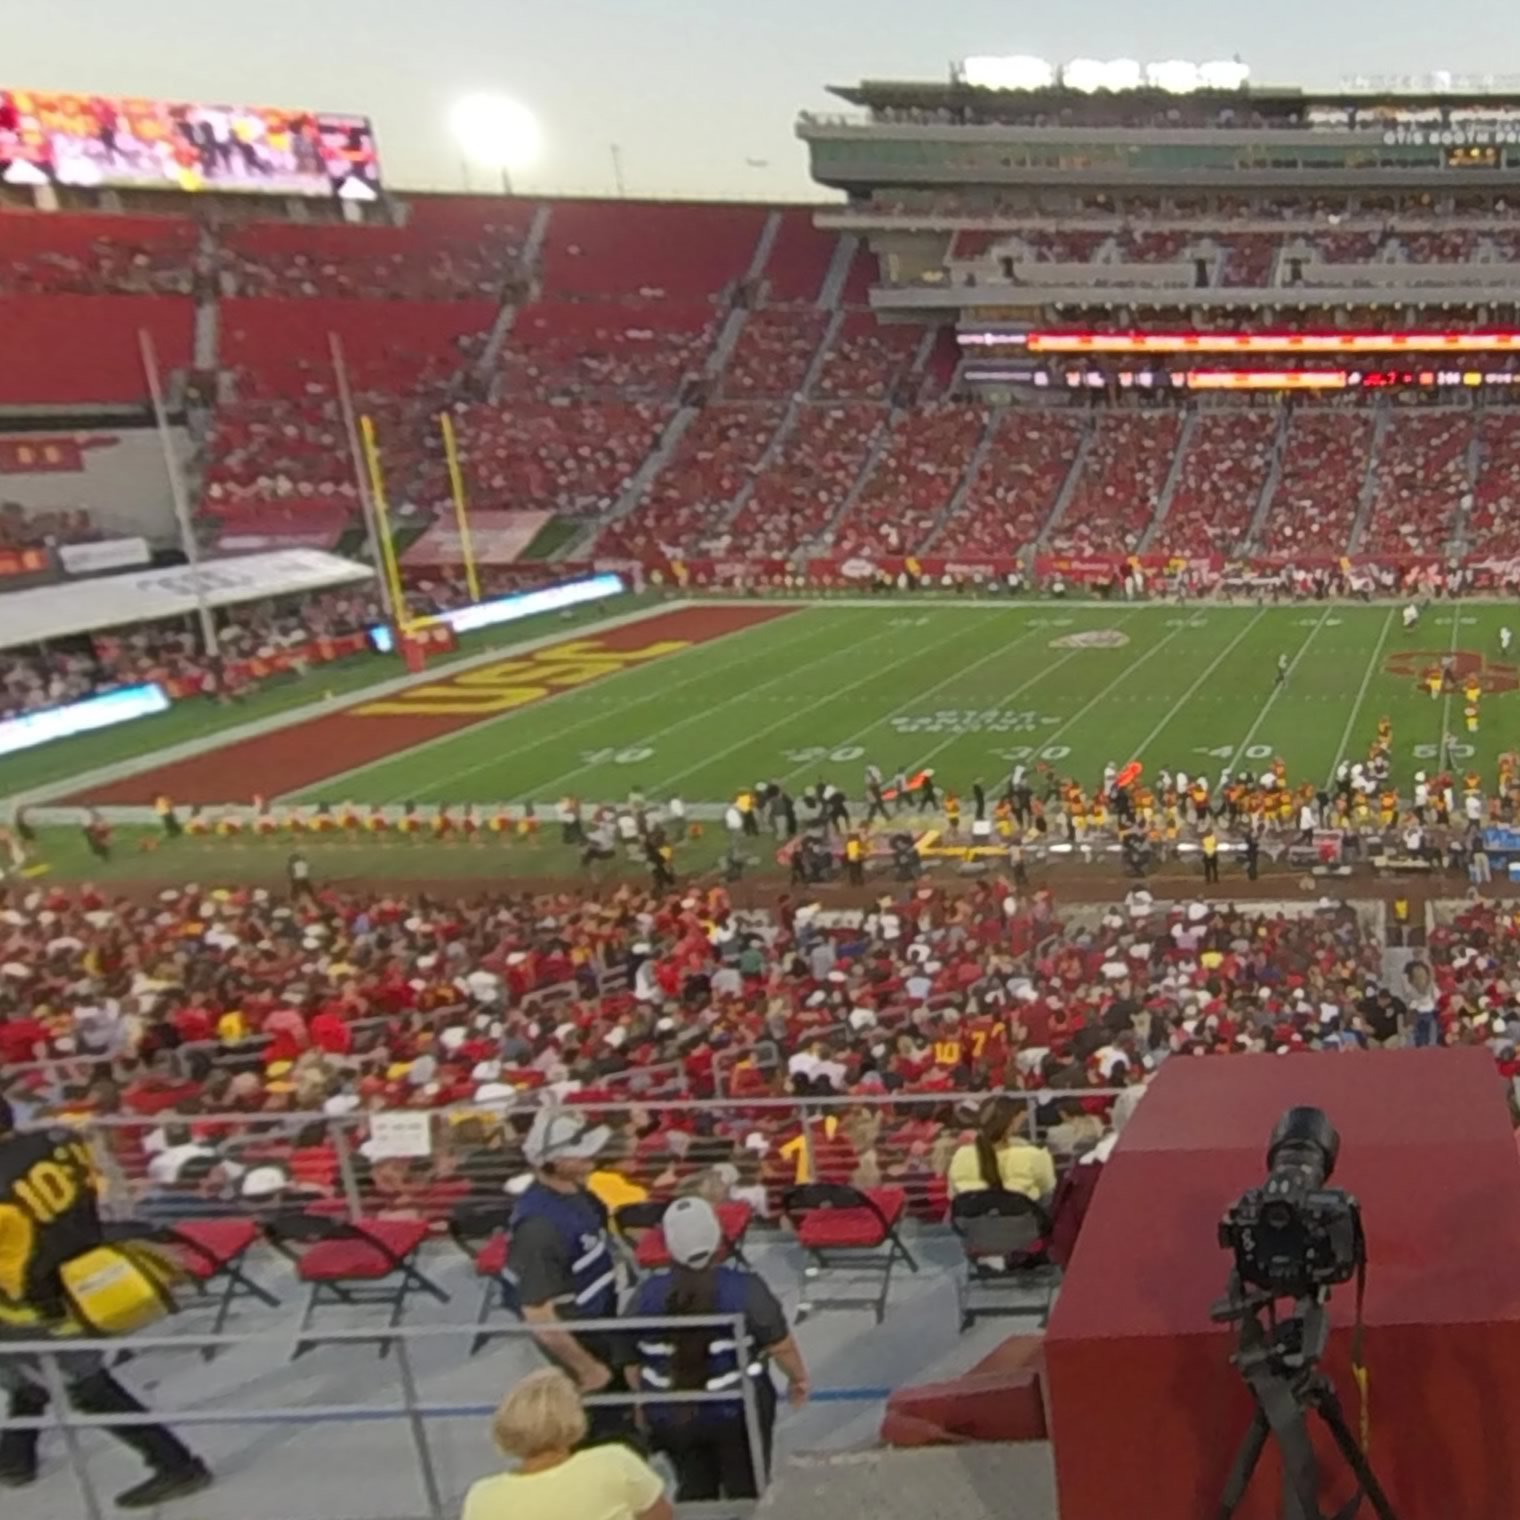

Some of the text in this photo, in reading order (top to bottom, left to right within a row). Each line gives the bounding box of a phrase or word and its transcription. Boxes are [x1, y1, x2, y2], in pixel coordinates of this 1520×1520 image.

[344, 640, 696, 716] USC
[1001, 745, 1072, 760] 30
[1207, 744, 1273, 758] 40
[1412, 744, 1475, 758] 50
[935, 1041, 959, 1064] 10
[970, 1031, 986, 1057] 7
[12, 1160, 76, 1222] 10
